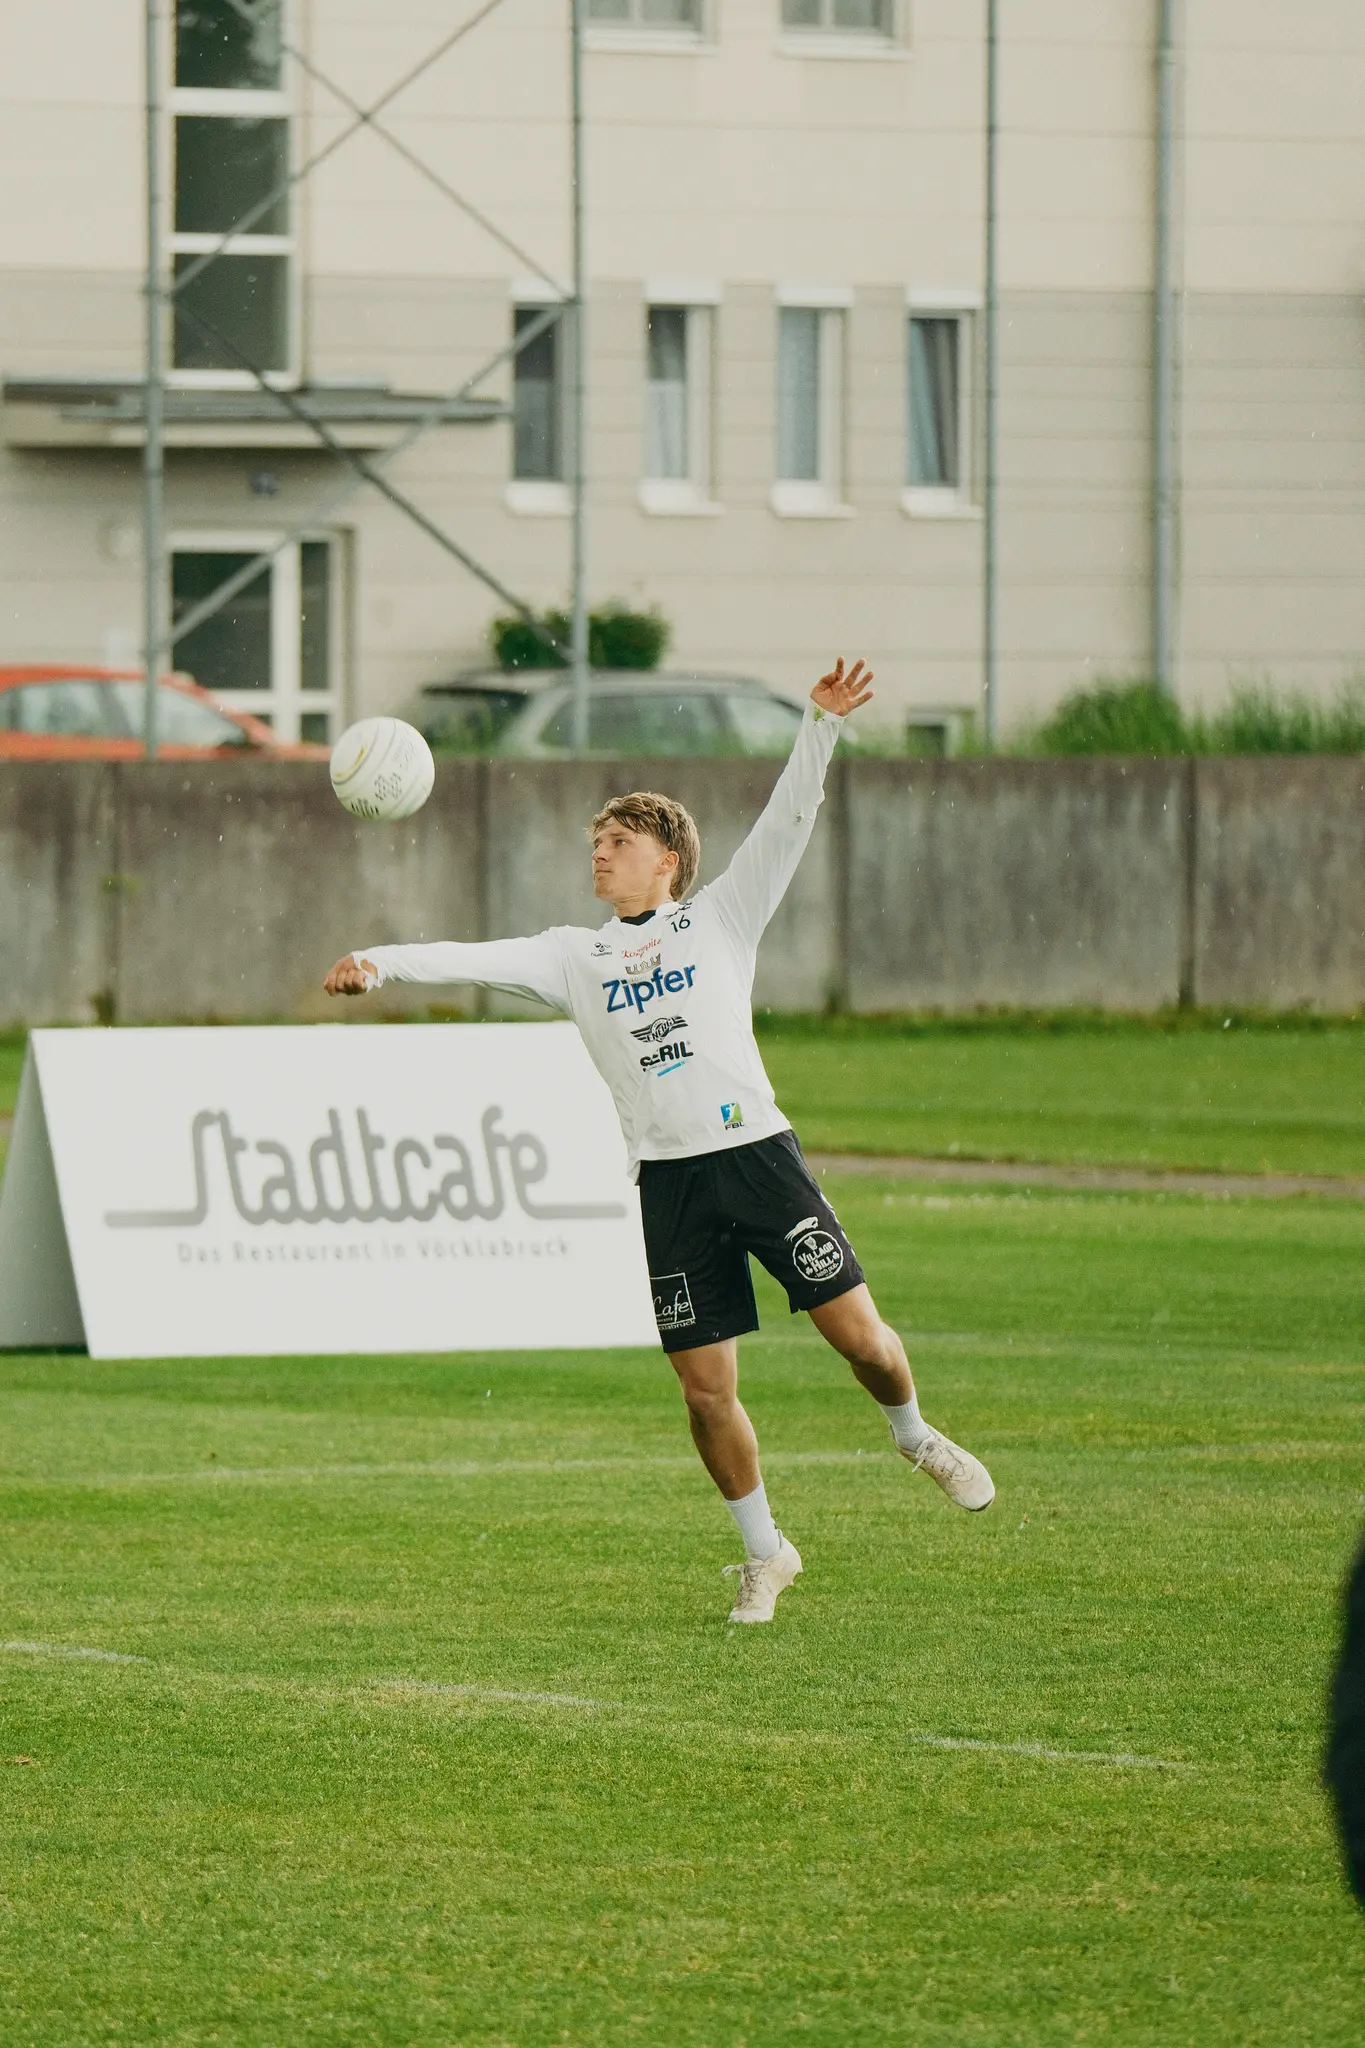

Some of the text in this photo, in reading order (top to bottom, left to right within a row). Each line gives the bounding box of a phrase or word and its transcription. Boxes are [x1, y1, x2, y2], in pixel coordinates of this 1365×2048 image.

[671, 914, 691, 933] 16
[602, 964, 696, 1014] Zipfer
[725, 1119, 744, 1131] FBL
[105, 1105, 627, 1227] Stadtcafe
[177, 1240, 223, 1264] Das
[232, 1240, 375, 1263] Restaurant
[381, 1236, 407, 1260] in
